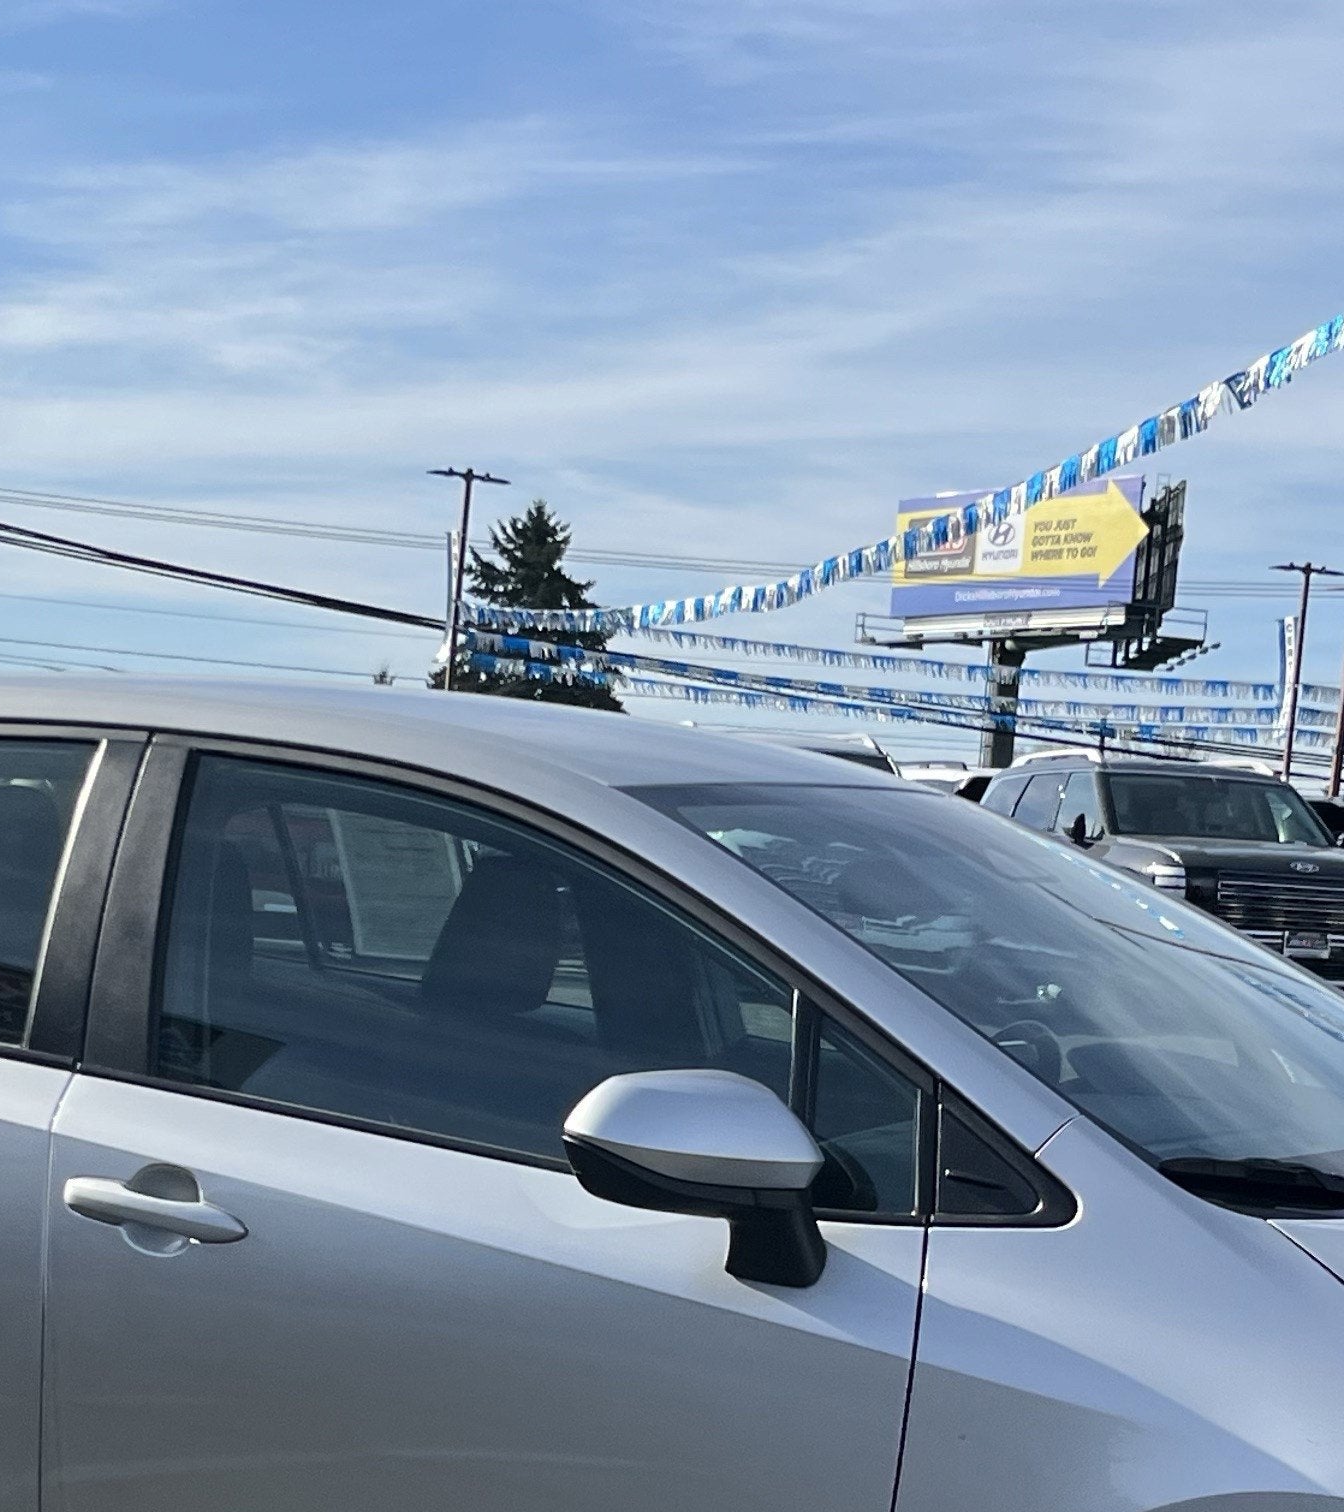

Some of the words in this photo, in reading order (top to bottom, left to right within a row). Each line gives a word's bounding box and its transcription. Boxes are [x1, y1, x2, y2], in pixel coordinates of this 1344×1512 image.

[1034, 520, 1053, 532] YOU
[1054, 518, 1077, 531] JUST
[1031, 534, 1061, 547] GOTTA
[1063, 531, 1094, 545] KNOW
[1031, 547, 1064, 561] WHERE
[1066, 547, 1079, 560] TO
